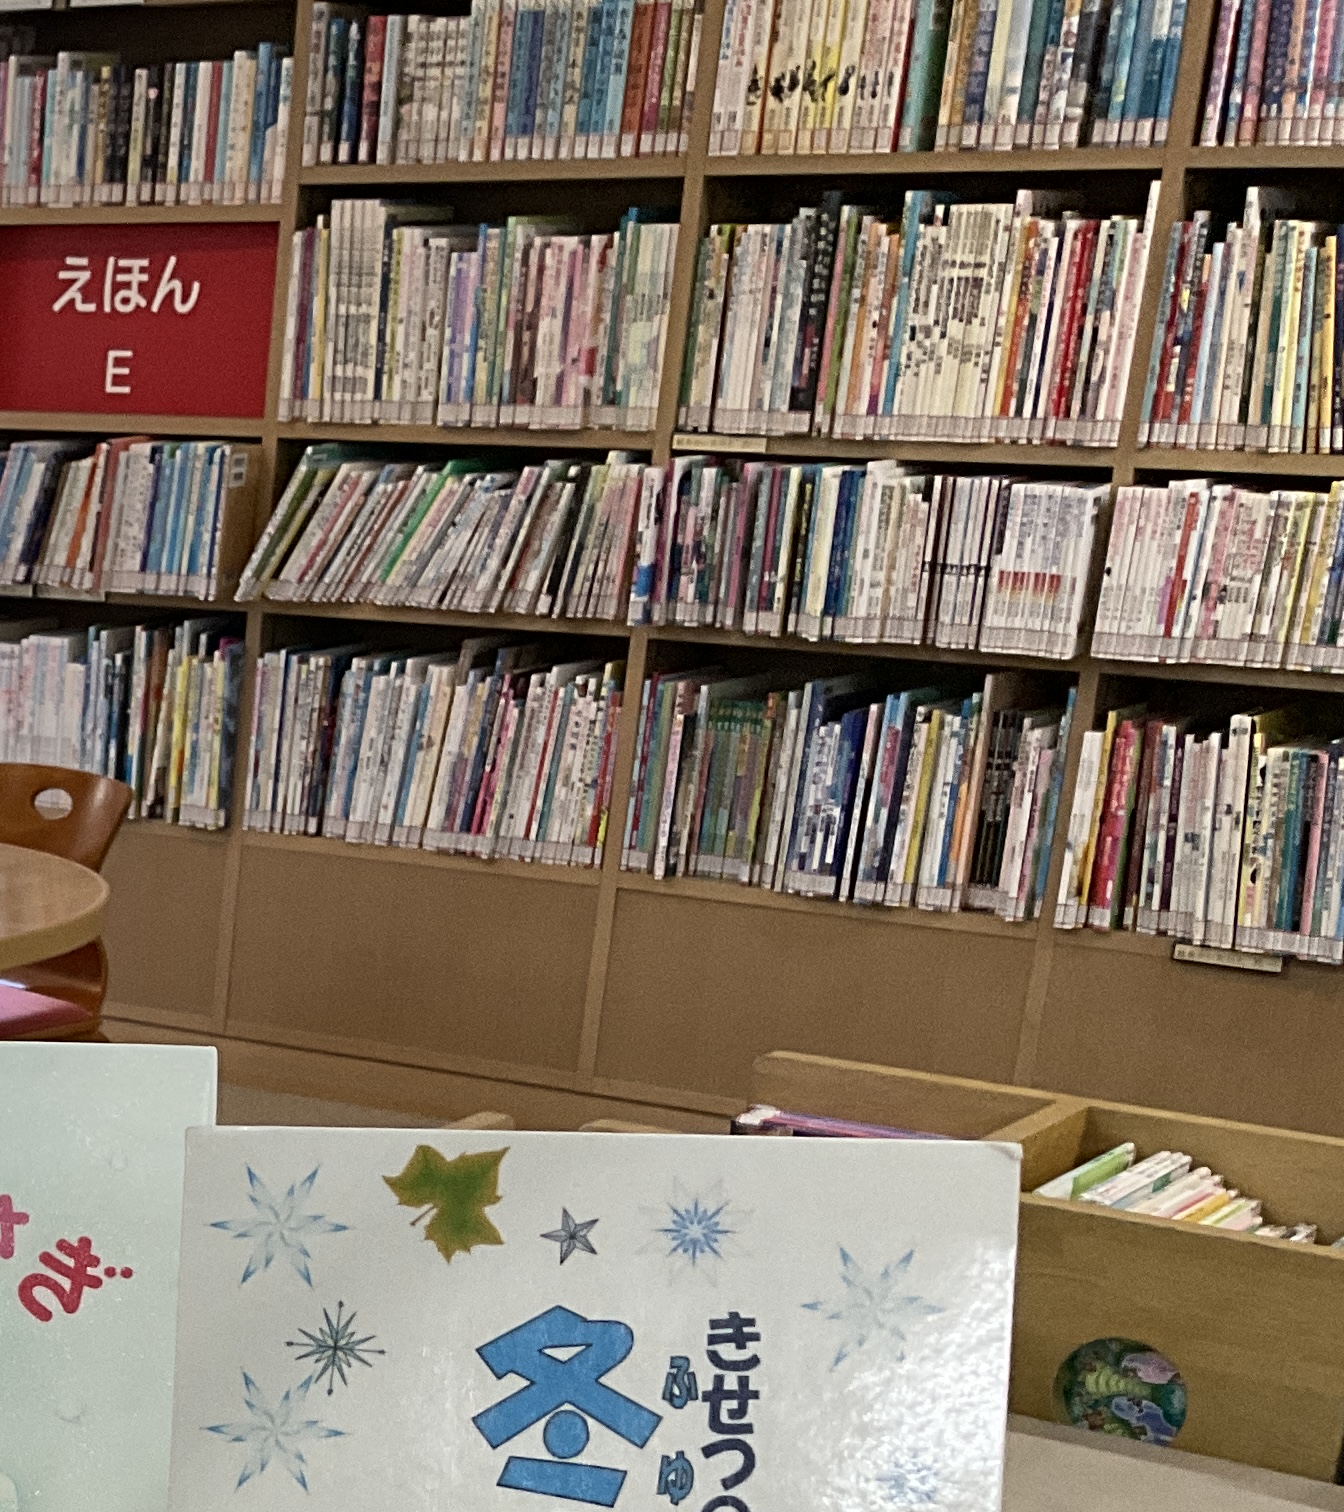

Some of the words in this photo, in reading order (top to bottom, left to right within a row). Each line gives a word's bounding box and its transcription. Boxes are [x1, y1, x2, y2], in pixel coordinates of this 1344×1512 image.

[51, 255, 201, 315] えほん
[103, 349, 134, 394] E
